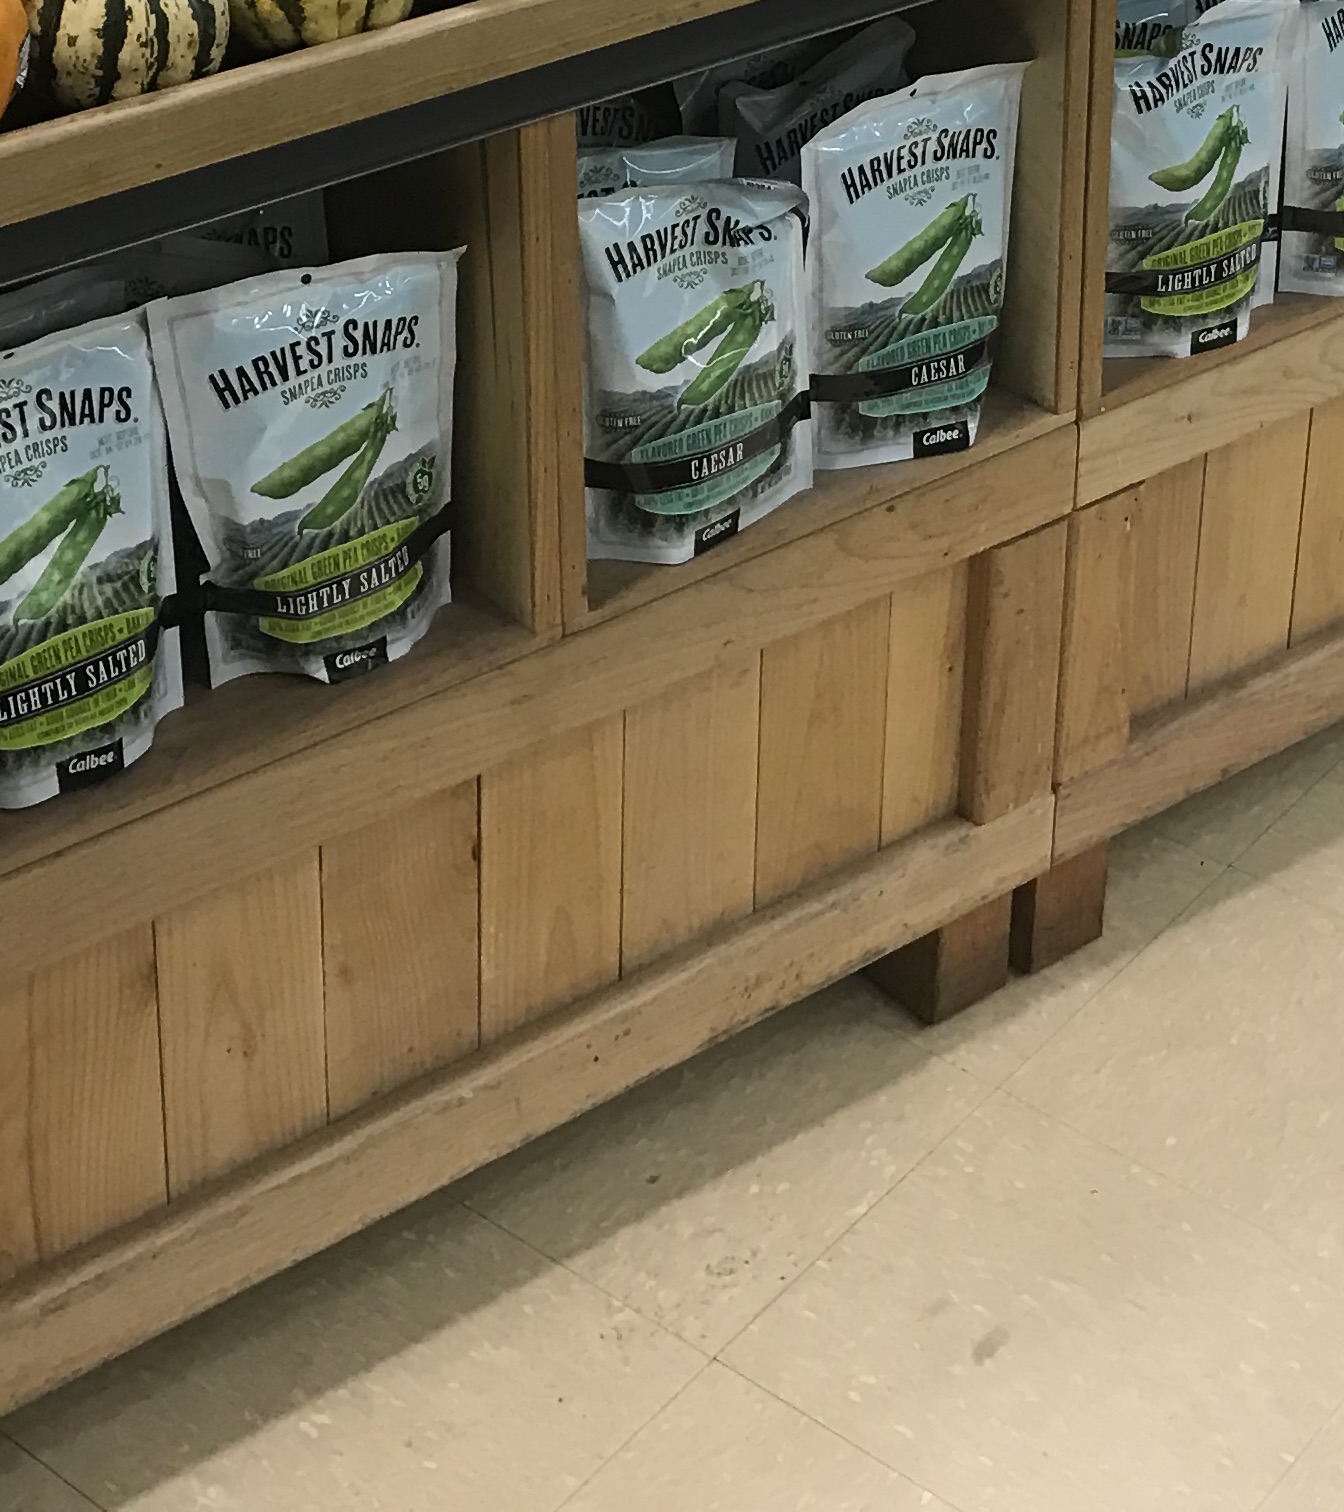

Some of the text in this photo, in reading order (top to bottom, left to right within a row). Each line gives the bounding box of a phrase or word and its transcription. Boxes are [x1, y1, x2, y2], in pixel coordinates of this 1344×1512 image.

[1128, 50, 1197, 115] HARVEST
[840, 136, 932, 205] HARVEST
[605, 215, 701, 283] HARVEST
[1157, 243, 1257, 292] LIGHTLY SALTED
[208, 329, 337, 413] HARVEST
[281, 362, 369, 406] SNAPEA CRISPS
[911, 354, 966, 386] CAESAR
[24, 435, 69, 462] CRISPS
[690, 442, 745, 480] CAESAR
[922, 428, 959, 446] Calbee
[276, 546, 410, 616] LIGHTLY SALTED
[86, 639, 147, 688] SALTED
[68, 751, 114, 774] Calbee
